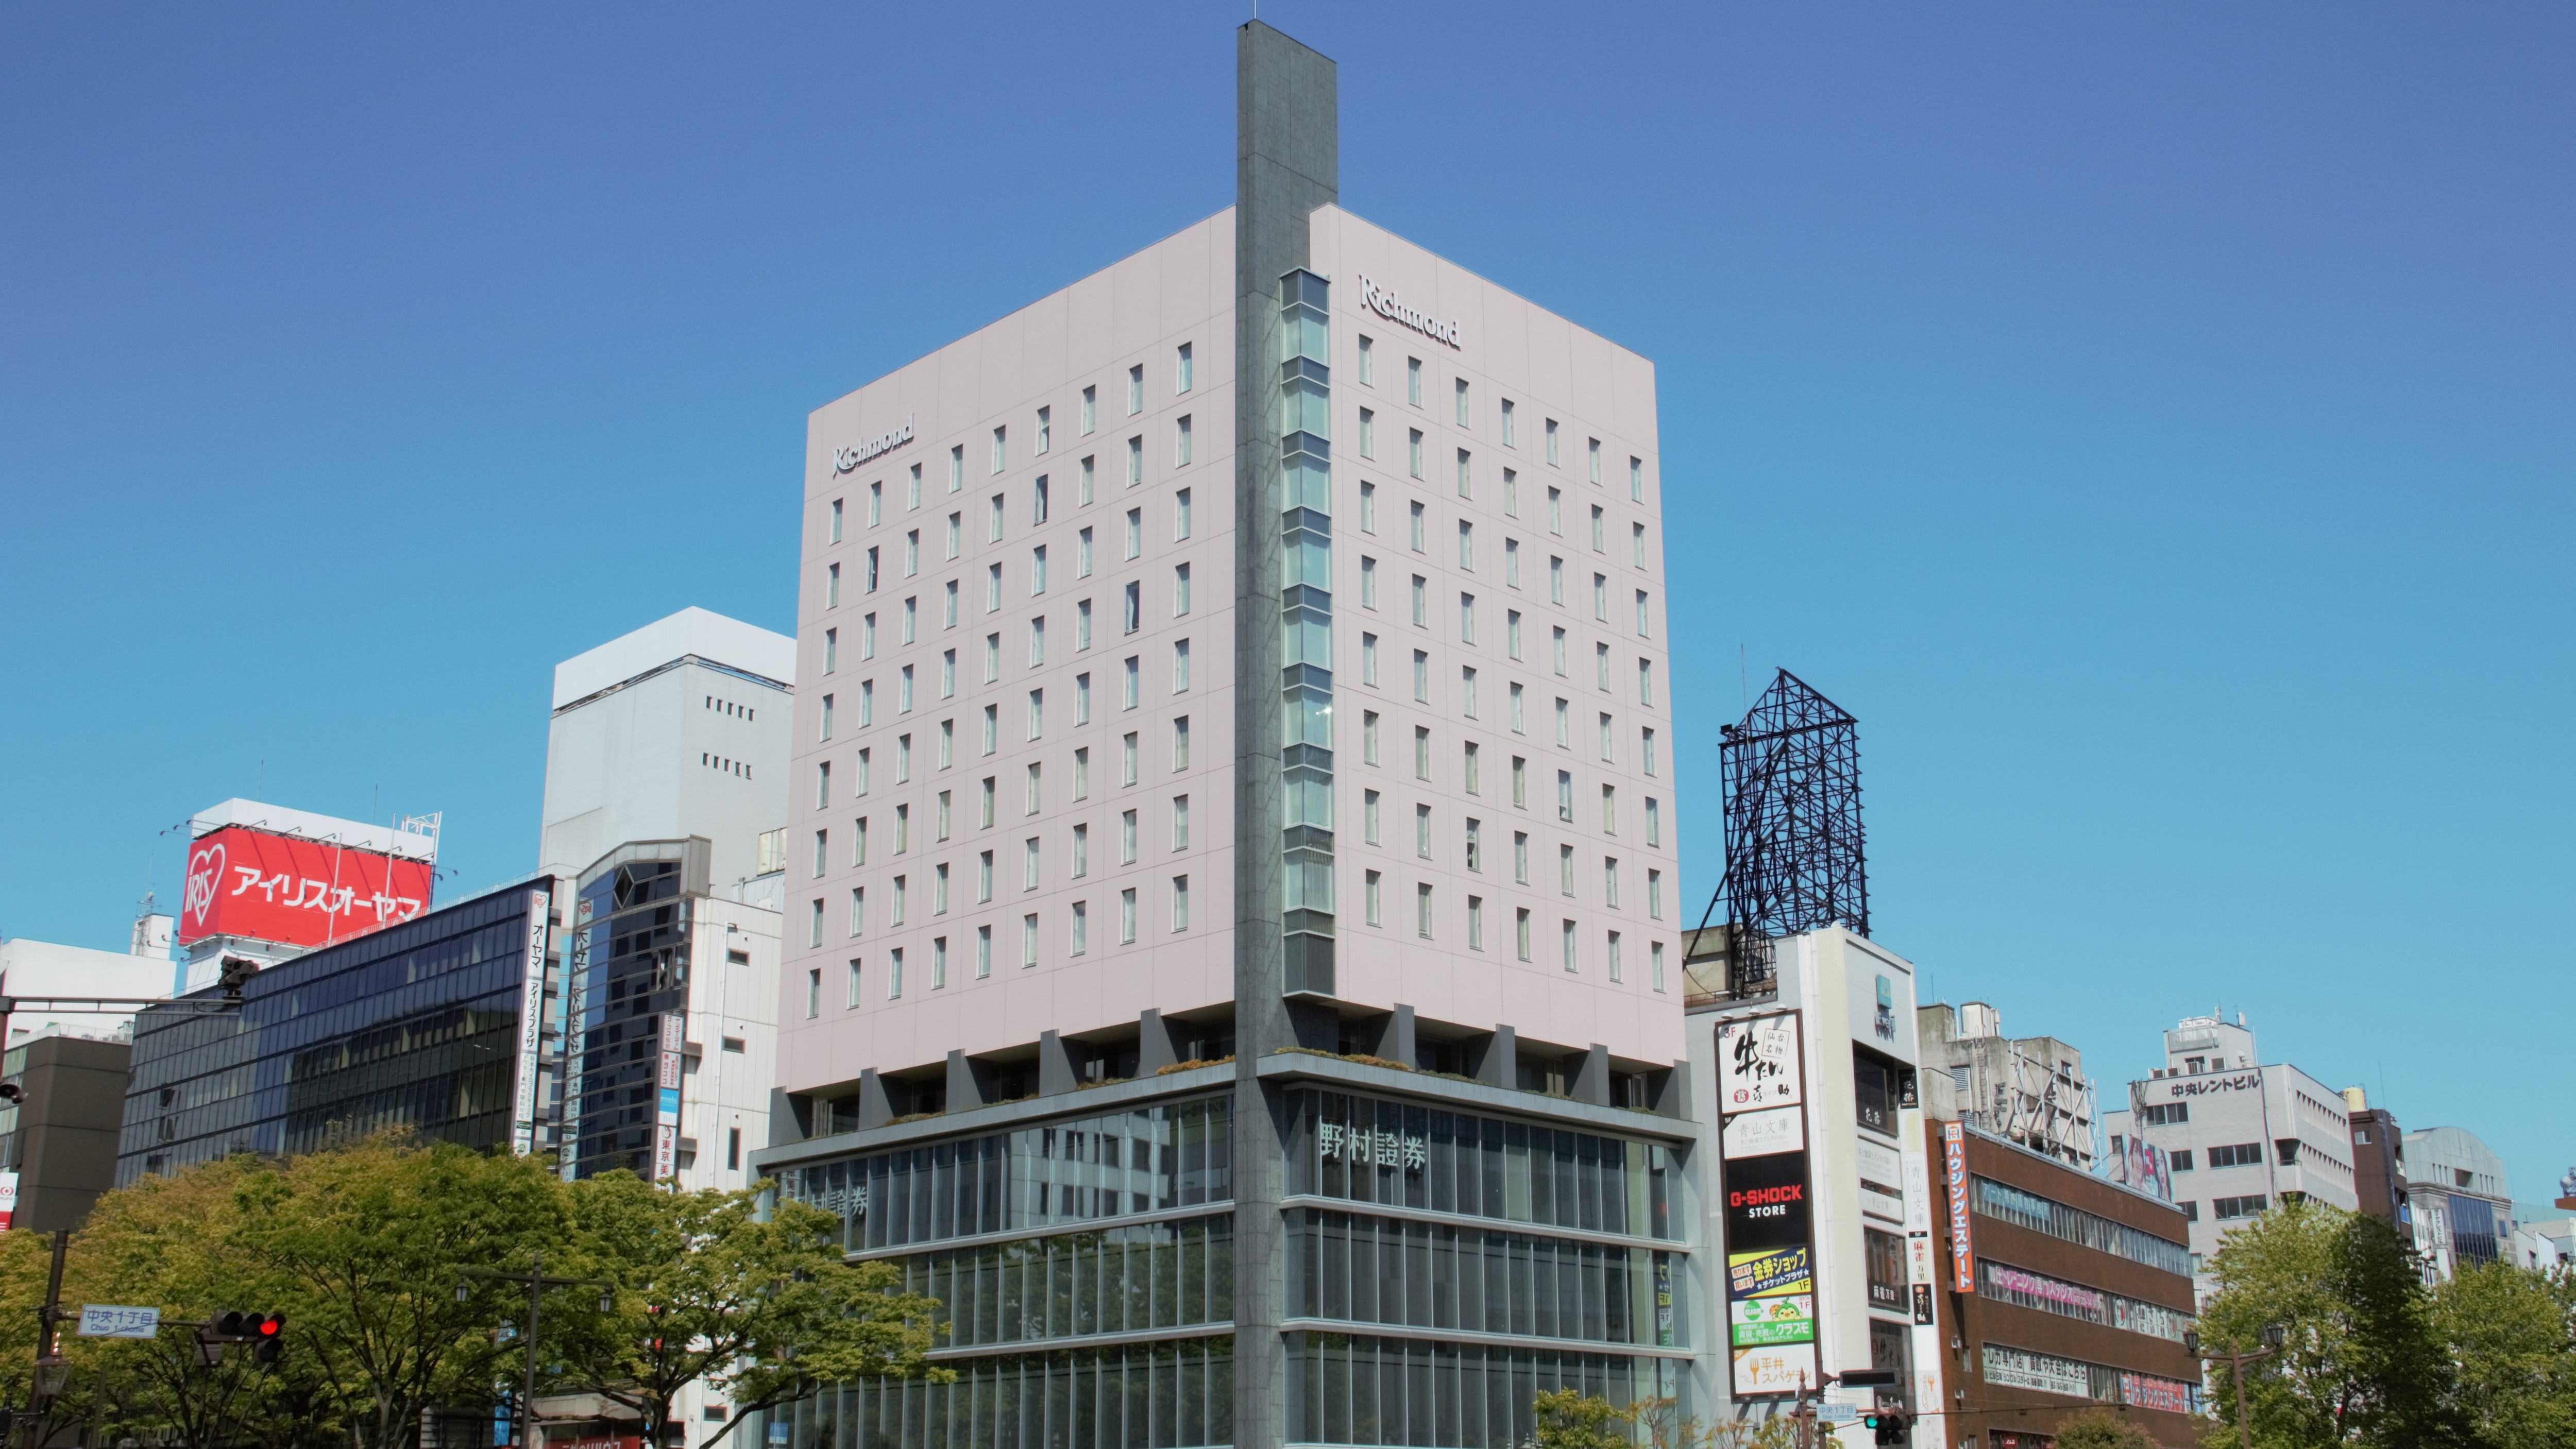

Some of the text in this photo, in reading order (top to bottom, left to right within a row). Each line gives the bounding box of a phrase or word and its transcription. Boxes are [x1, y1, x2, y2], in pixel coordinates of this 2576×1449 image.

[1359, 274, 1461, 347] Richmond
[832, 412, 914, 480] Richmond
[185, 868, 213, 912] IRIS
[232, 866, 420, 922] アイリスオーヤマ
[532, 925, 544, 968] オーヤマ
[526, 982, 538, 1047] アイリスプラザ
[1723, 1027, 1736, 1038] 3F
[1734, 1030, 1784, 1082] 牛たん
[2172, 1075, 2260, 1097] 中央レントビル
[1739, 1118, 1789, 1138] 青山文庫
[660, 1139, 671, 1179] 東京美
[1321, 1123, 1426, 1169] 野村證券
[794, 1186, 868, 1218] 村證券
[1731, 1184, 1803, 1207] G-SHOCK
[1749, 1204, 1786, 1218] STORE
[1911, 1166, 1924, 1225] 青山文庫
[1948, 1143, 1972, 1288] ハウジングエステート
[1733, 1266, 1750, 1276] 売ります
[1753, 1248, 1806, 1282] 金券ショップ
[1762, 1269, 1803, 1289] チケットプラザ
[1735, 1278, 1753, 1288] 買います
[1798, 1280, 1809, 1290] 1F
[88, 1309, 152, 1325] 中央1丁目
[1776, 1322, 1809, 1336] クラスモ
[1761, 1356, 1784, 1371] 平井
